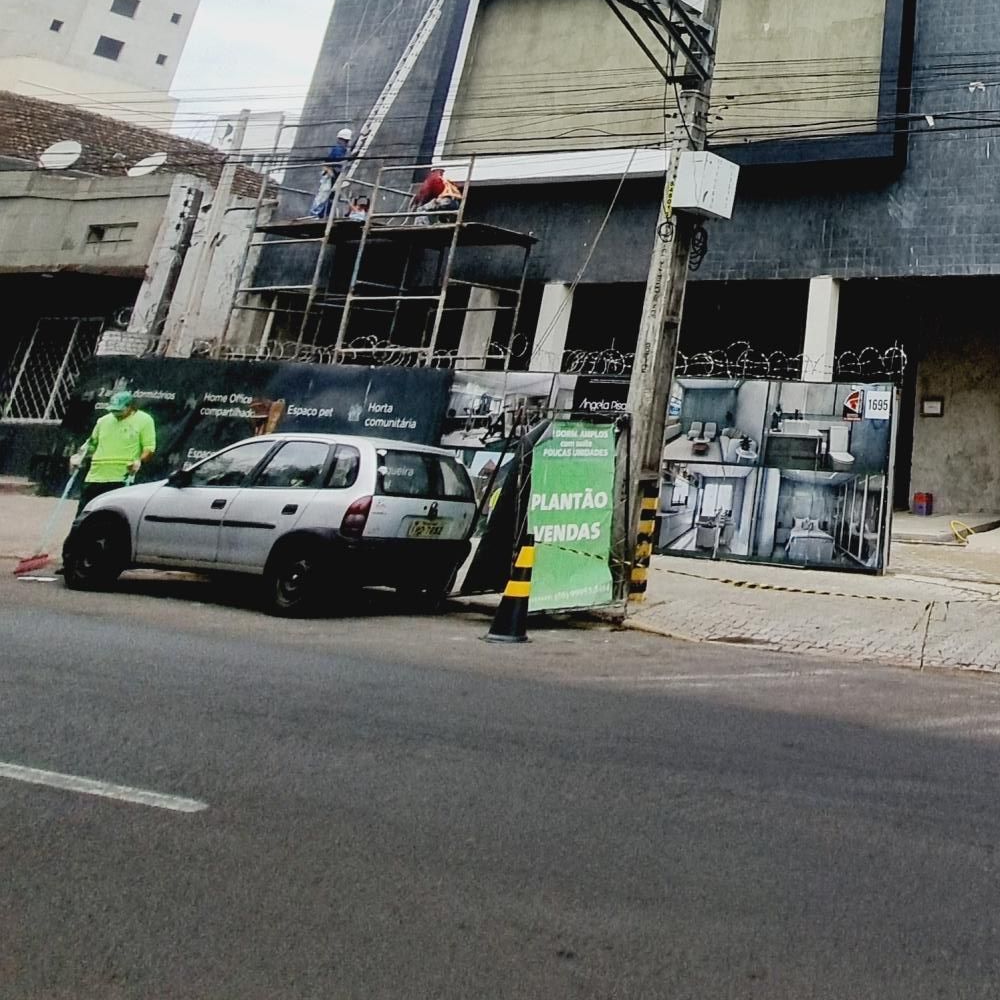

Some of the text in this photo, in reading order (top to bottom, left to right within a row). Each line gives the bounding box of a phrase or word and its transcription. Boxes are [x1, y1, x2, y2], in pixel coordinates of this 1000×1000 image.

[203, 392, 253, 404] Home Office
[579, 397, 610, 411] Angela
[286, 404, 334, 418] Espaço pet
[367, 402, 394, 414] Horta
[868, 399, 889, 411] 1695
[364, 417, 417, 429] comunitária
[542, 448, 572, 457] POUCAS
[530, 488, 609, 511] PLANTÃO
[533, 522, 601, 542] VENDAS
